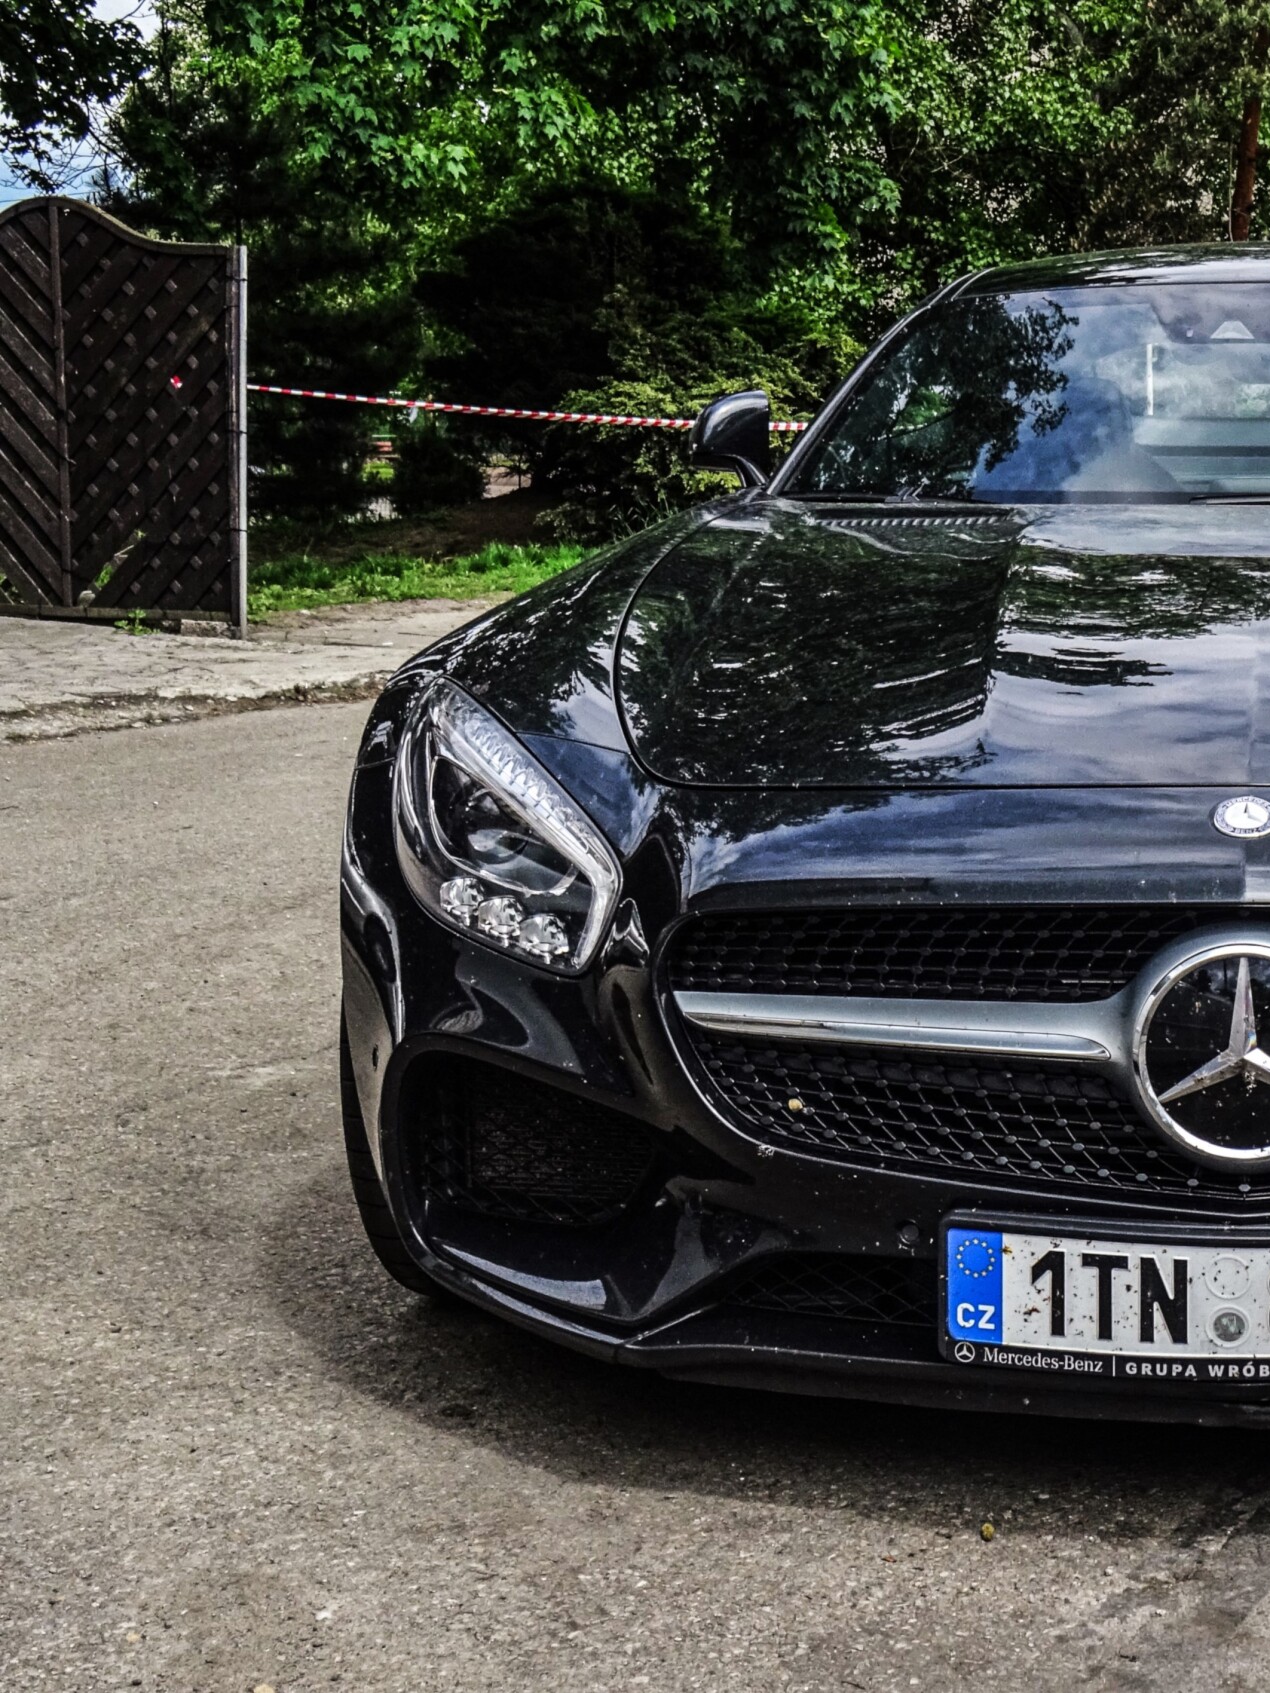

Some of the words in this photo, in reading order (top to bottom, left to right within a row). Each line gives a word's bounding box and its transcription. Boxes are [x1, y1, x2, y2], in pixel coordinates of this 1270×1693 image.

[1030, 1250, 1189, 1344] 1TN
[956, 1302, 996, 1330] CZ
[983, 1347, 1103, 1373] Mercedes-Benz
[1125, 1361, 1197, 1378] GRUPA
